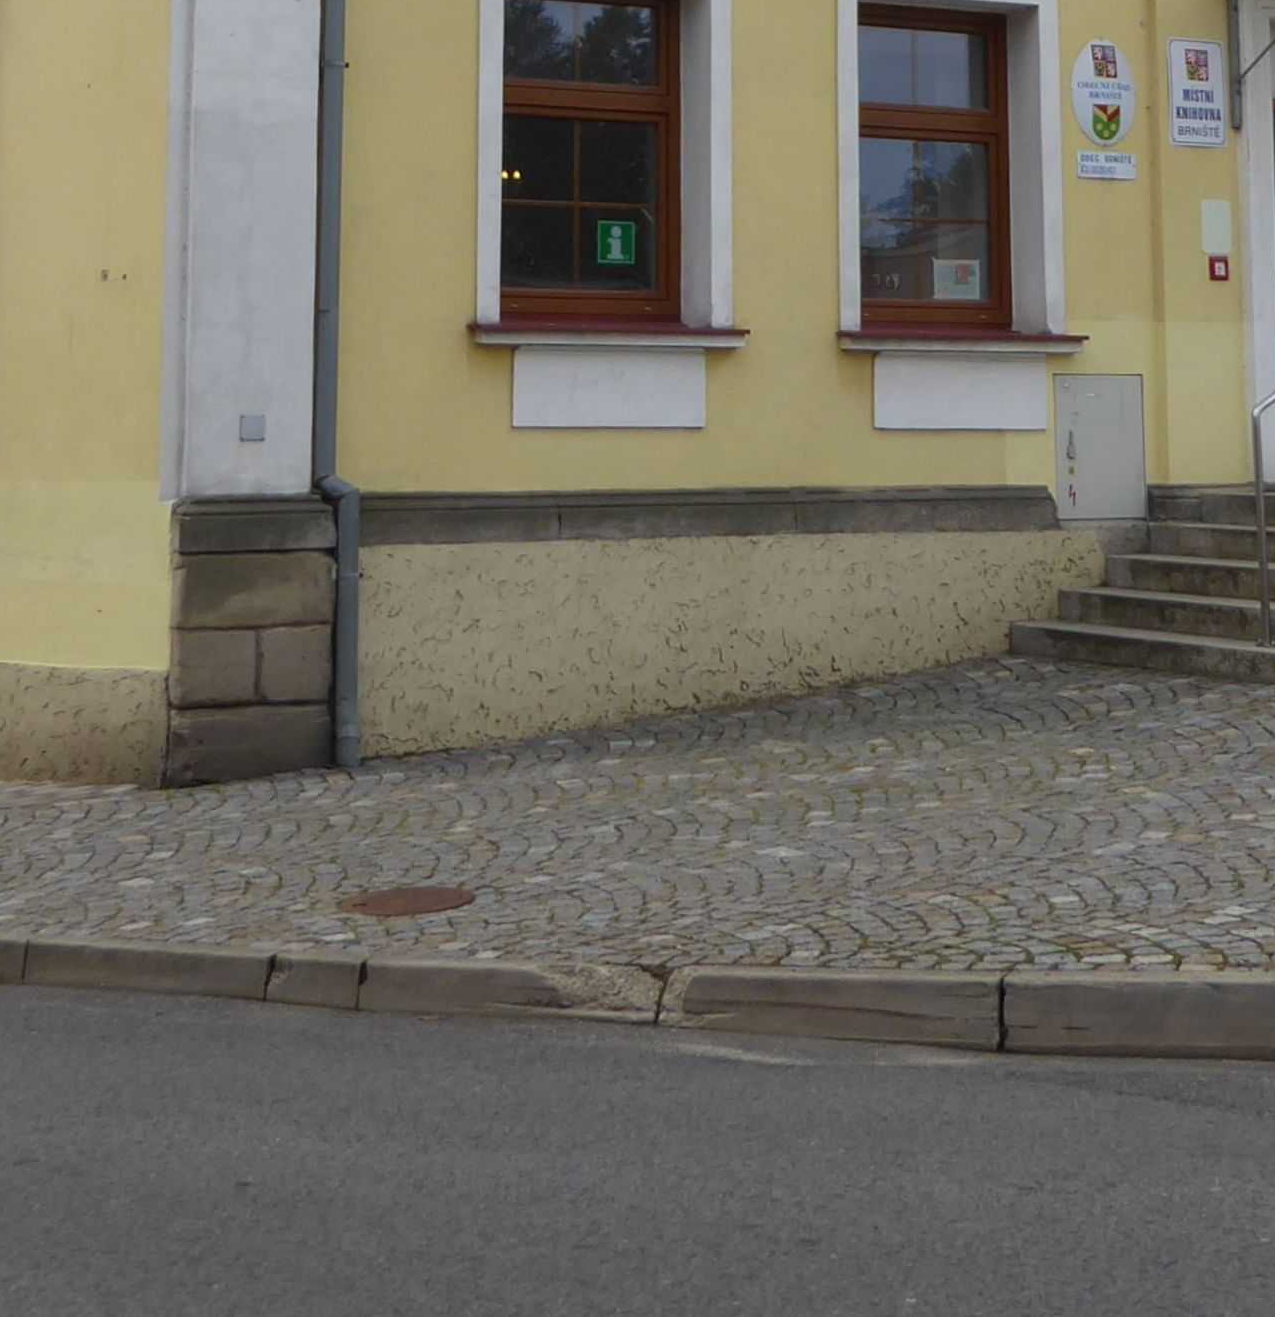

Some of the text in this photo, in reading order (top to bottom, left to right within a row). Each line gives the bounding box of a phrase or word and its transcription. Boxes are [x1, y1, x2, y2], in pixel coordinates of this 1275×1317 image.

[1182, 87, 1215, 103] MÍSTNÍ
[1176, 106, 1222, 122] KNIHOVNA
[1177, 123, 1221, 138] BRNIŠTĚ
